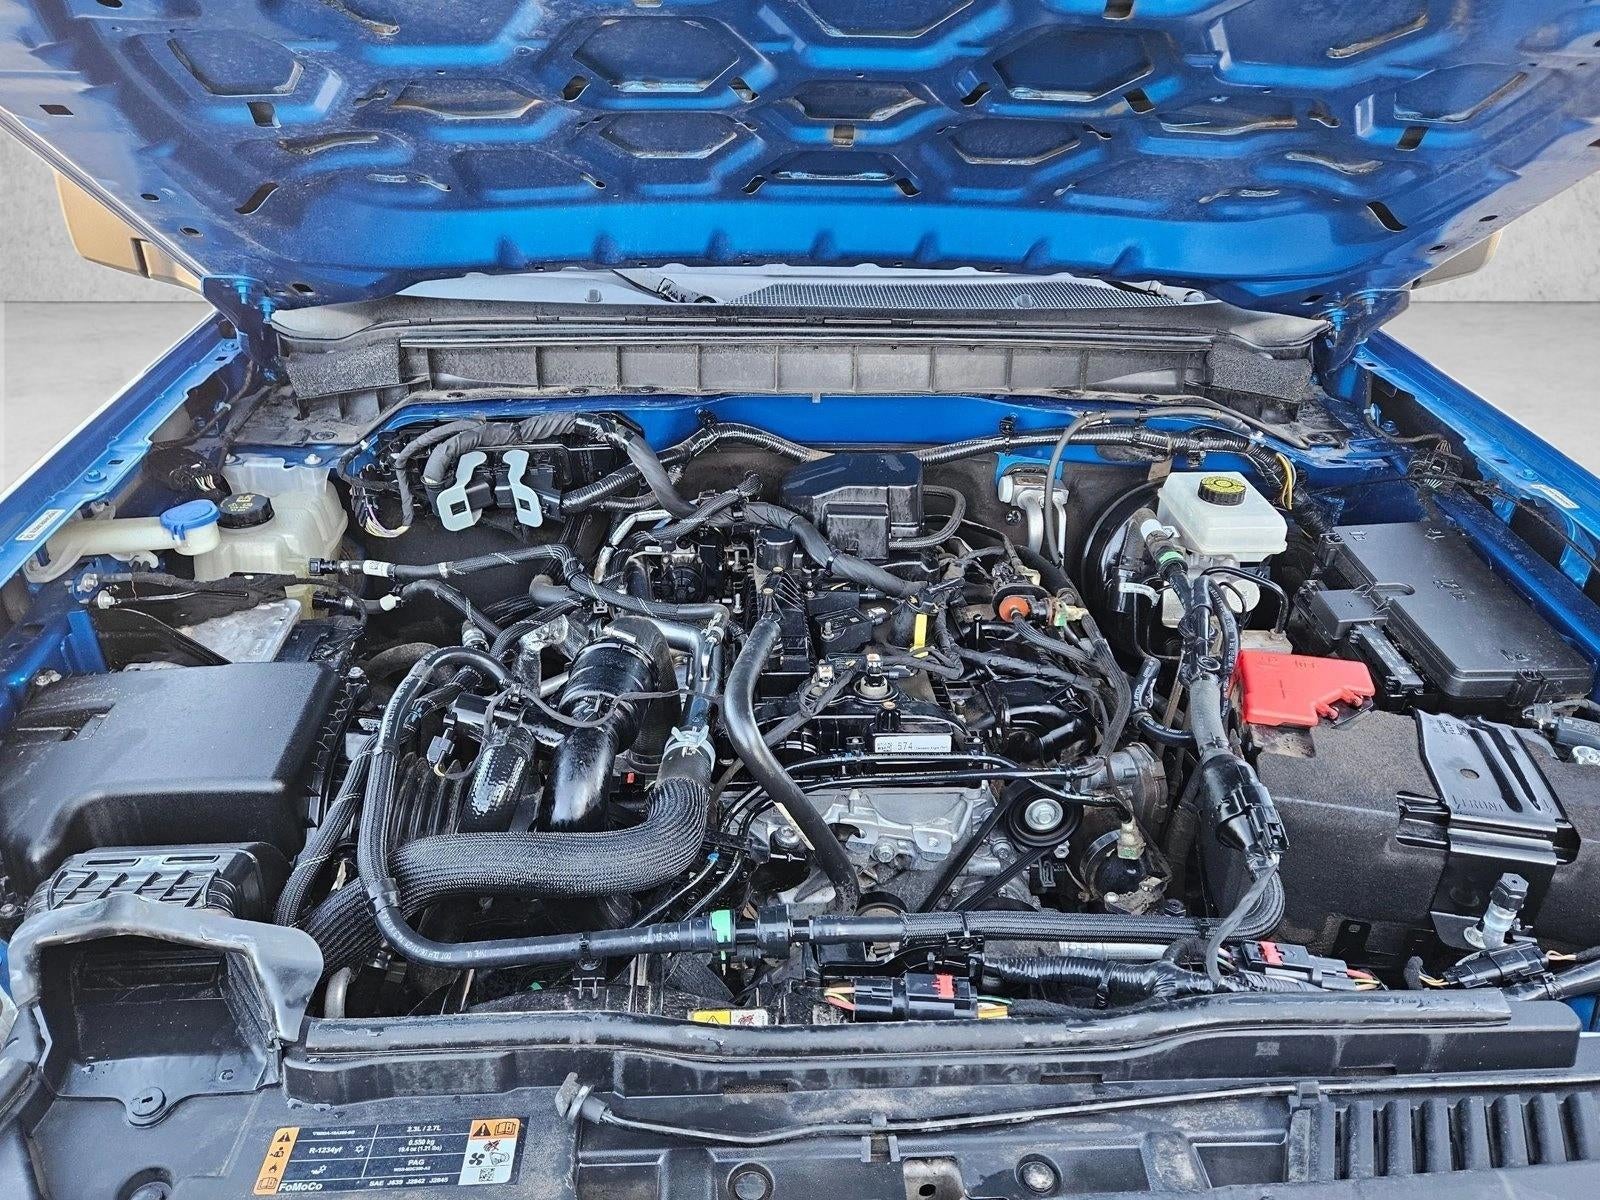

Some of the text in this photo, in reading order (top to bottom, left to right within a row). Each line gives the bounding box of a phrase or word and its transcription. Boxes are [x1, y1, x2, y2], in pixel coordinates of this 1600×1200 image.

[426, 1138, 436, 1146] kg
[308, 1145, 343, 1154] R-1234yf
[278, 1181, 323, 1192] FoMoCo
